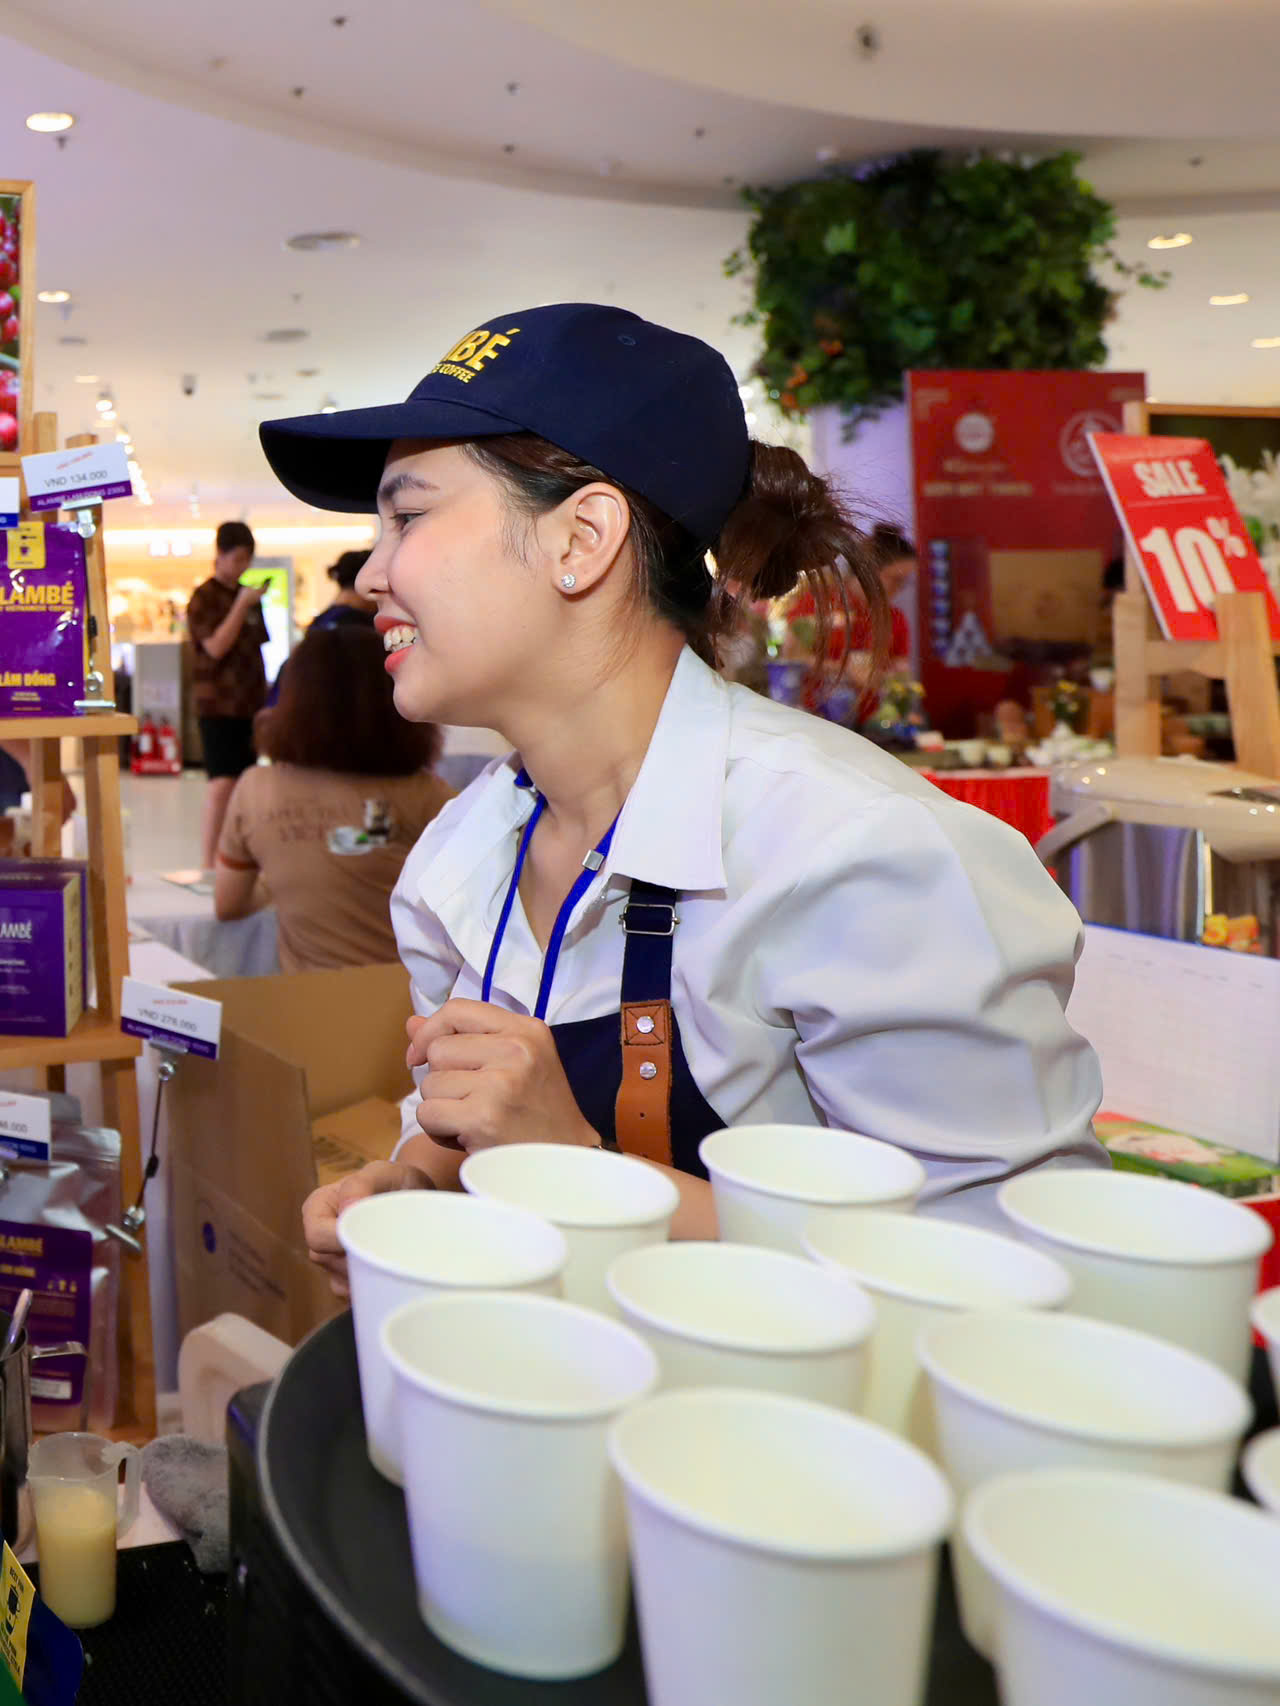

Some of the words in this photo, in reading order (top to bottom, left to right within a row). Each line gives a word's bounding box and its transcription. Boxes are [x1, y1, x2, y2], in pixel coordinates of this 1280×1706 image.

[44, 476, 67, 488] VND
[70, 470, 108, 484] 134.000
[1133, 459, 1207, 498] SALE
[137, 1008, 159, 1021] VND
